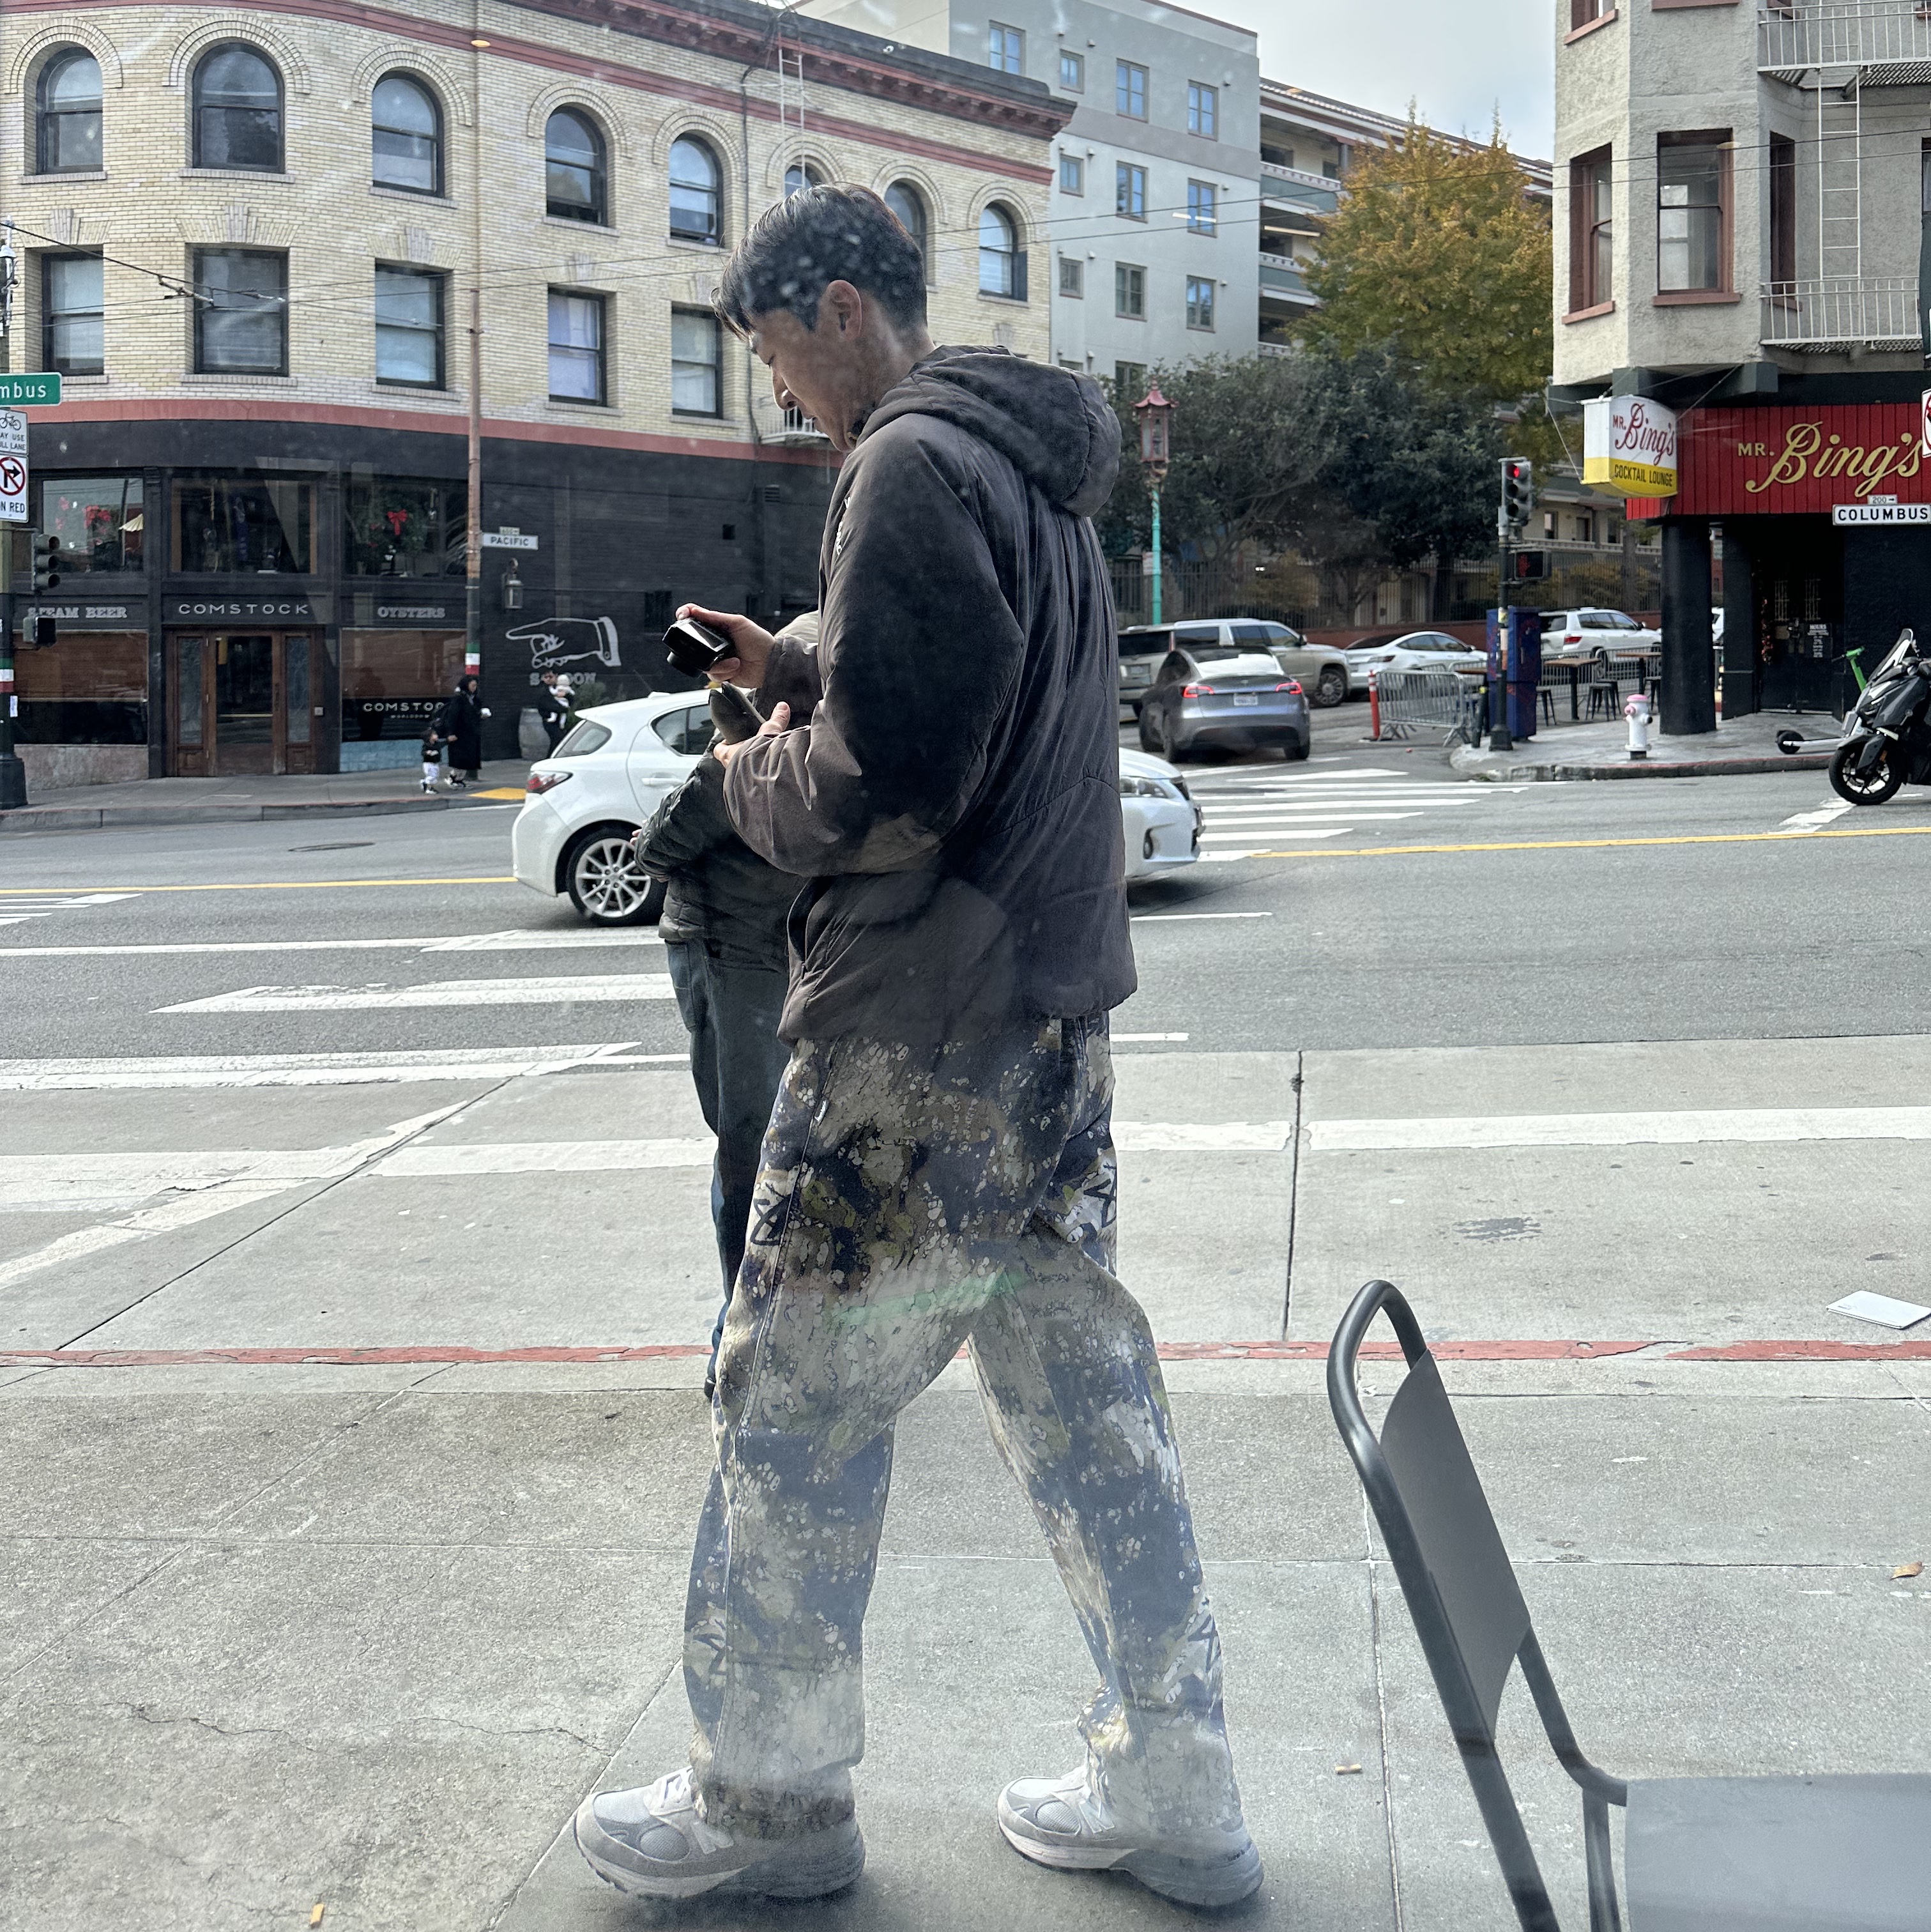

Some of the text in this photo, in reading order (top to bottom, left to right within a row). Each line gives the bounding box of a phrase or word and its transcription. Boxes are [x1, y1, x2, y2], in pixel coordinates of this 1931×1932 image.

[1613, 403, 1674, 466] MR. Bing's
[1737, 421, 1923, 498] MR. Bing's
[1614, 464, 1672, 487] COCKTAIL LOUNGE
[1872, 496, 1887, 504] 200
[9, 502, 26, 514] RED
[1838, 508, 1928, 521] COLUMBUS
[490, 536, 529, 546] PACIFIC
[86, 607, 128, 618] BEER
[179, 603, 309, 615] COMSTOCK
[378, 606, 446, 618] OYSTERS
